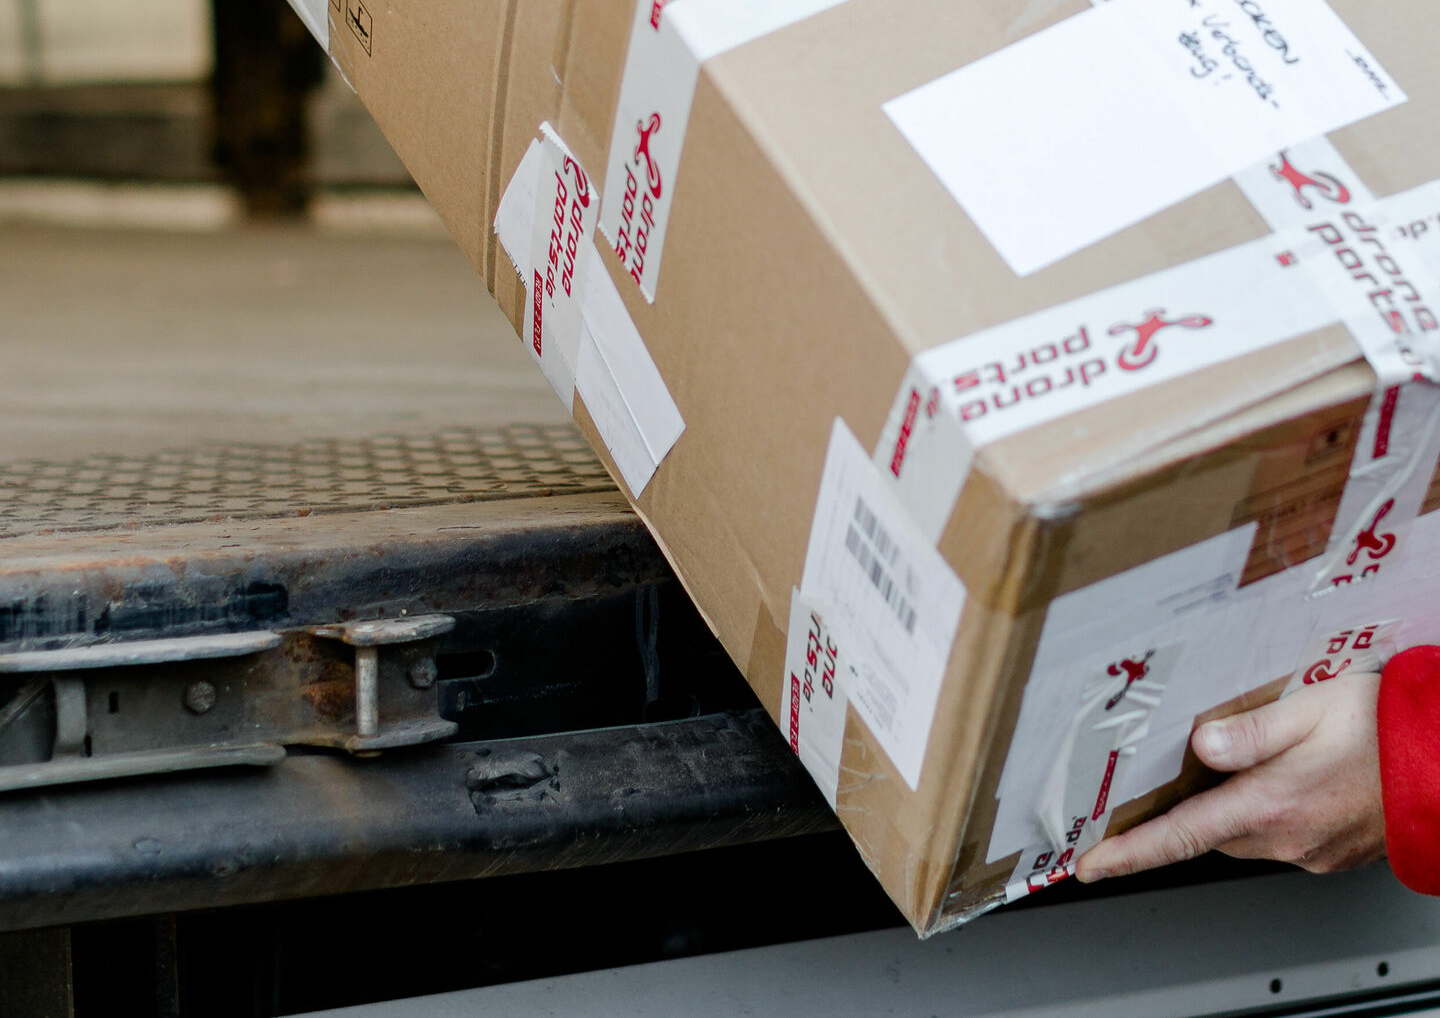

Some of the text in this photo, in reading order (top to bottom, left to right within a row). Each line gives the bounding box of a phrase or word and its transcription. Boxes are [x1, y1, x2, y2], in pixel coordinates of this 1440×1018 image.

[545, 170, 568, 299] parts.de
[561, 199, 584, 299] drone
[1340, 211, 1440, 332] drone
[959, 357, 1107, 422] drone
